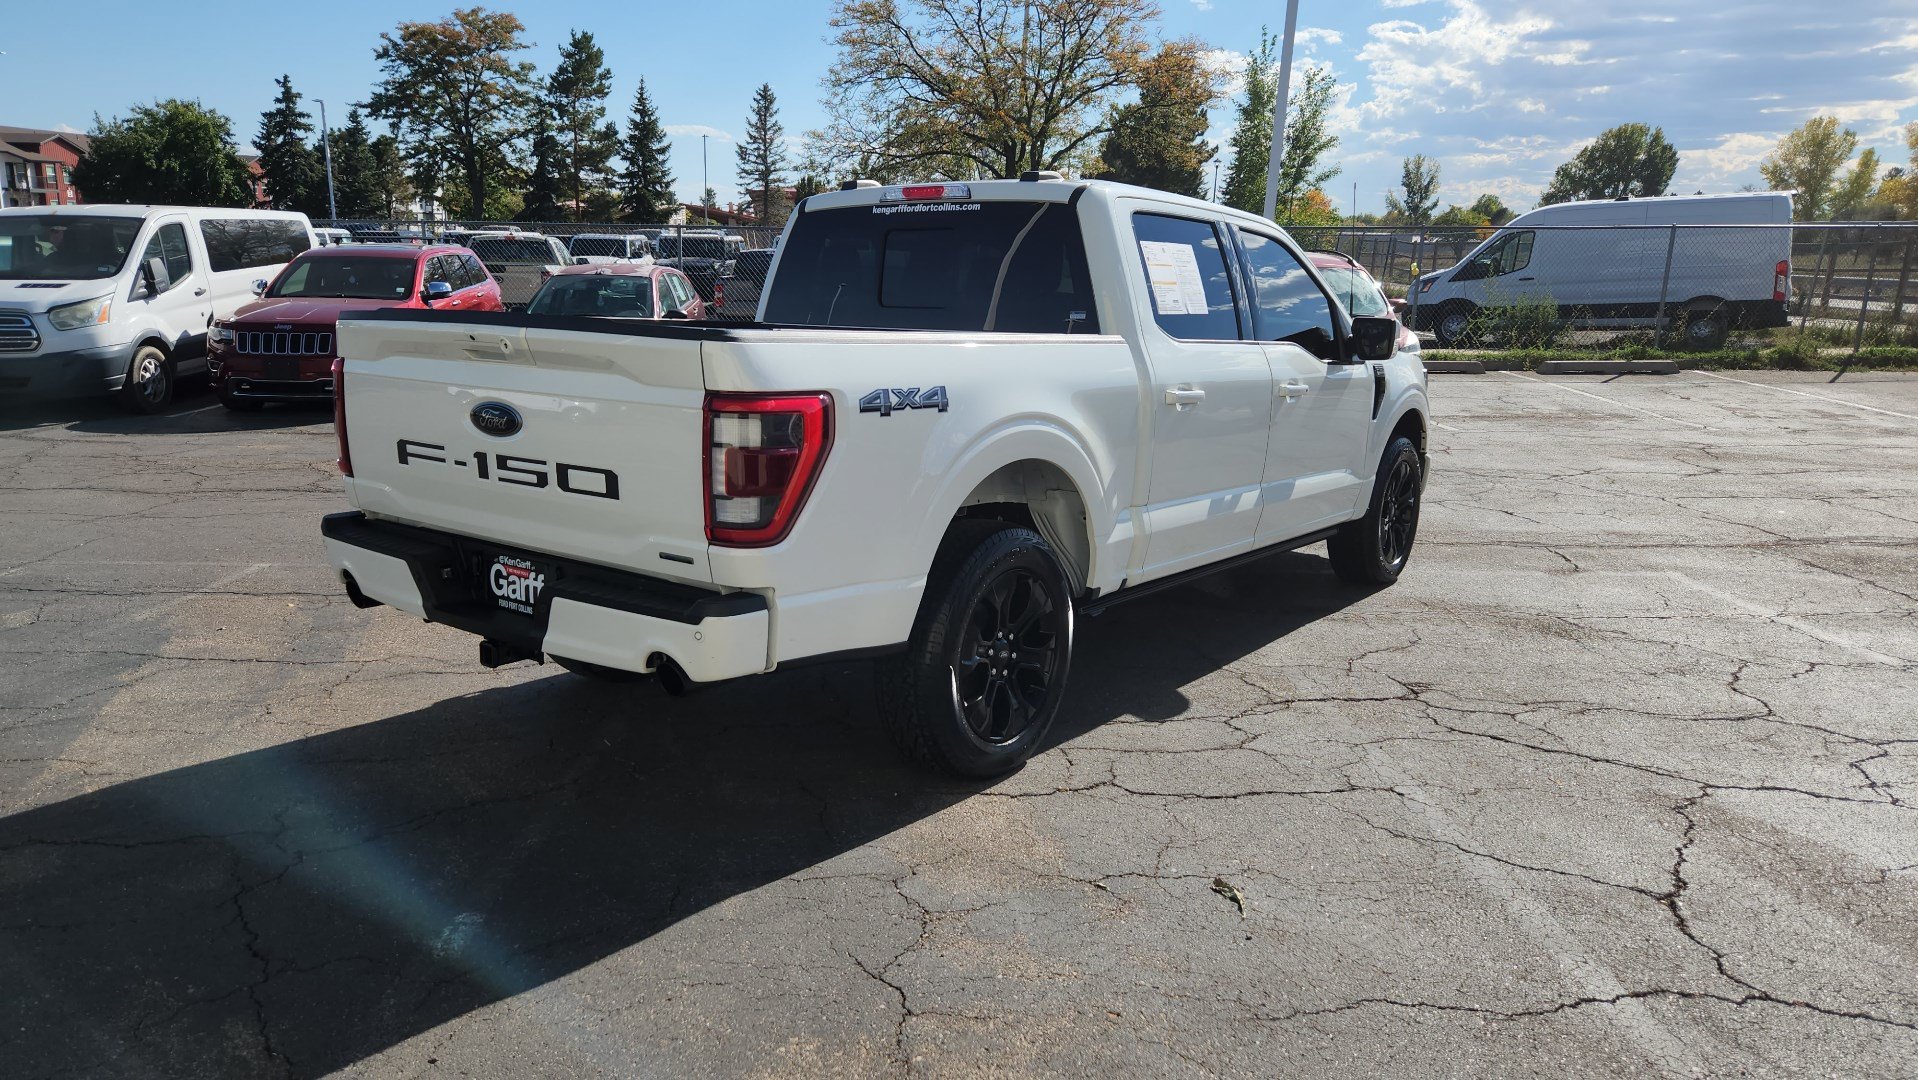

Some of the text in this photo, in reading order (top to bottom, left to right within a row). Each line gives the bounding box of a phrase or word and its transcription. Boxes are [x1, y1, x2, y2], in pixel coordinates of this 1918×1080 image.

[480, 408, 508, 429] Ford
[396, 438, 620, 501] F-150
[490, 562, 545, 604] Garff
[518, 603, 533, 615] COLLINS
